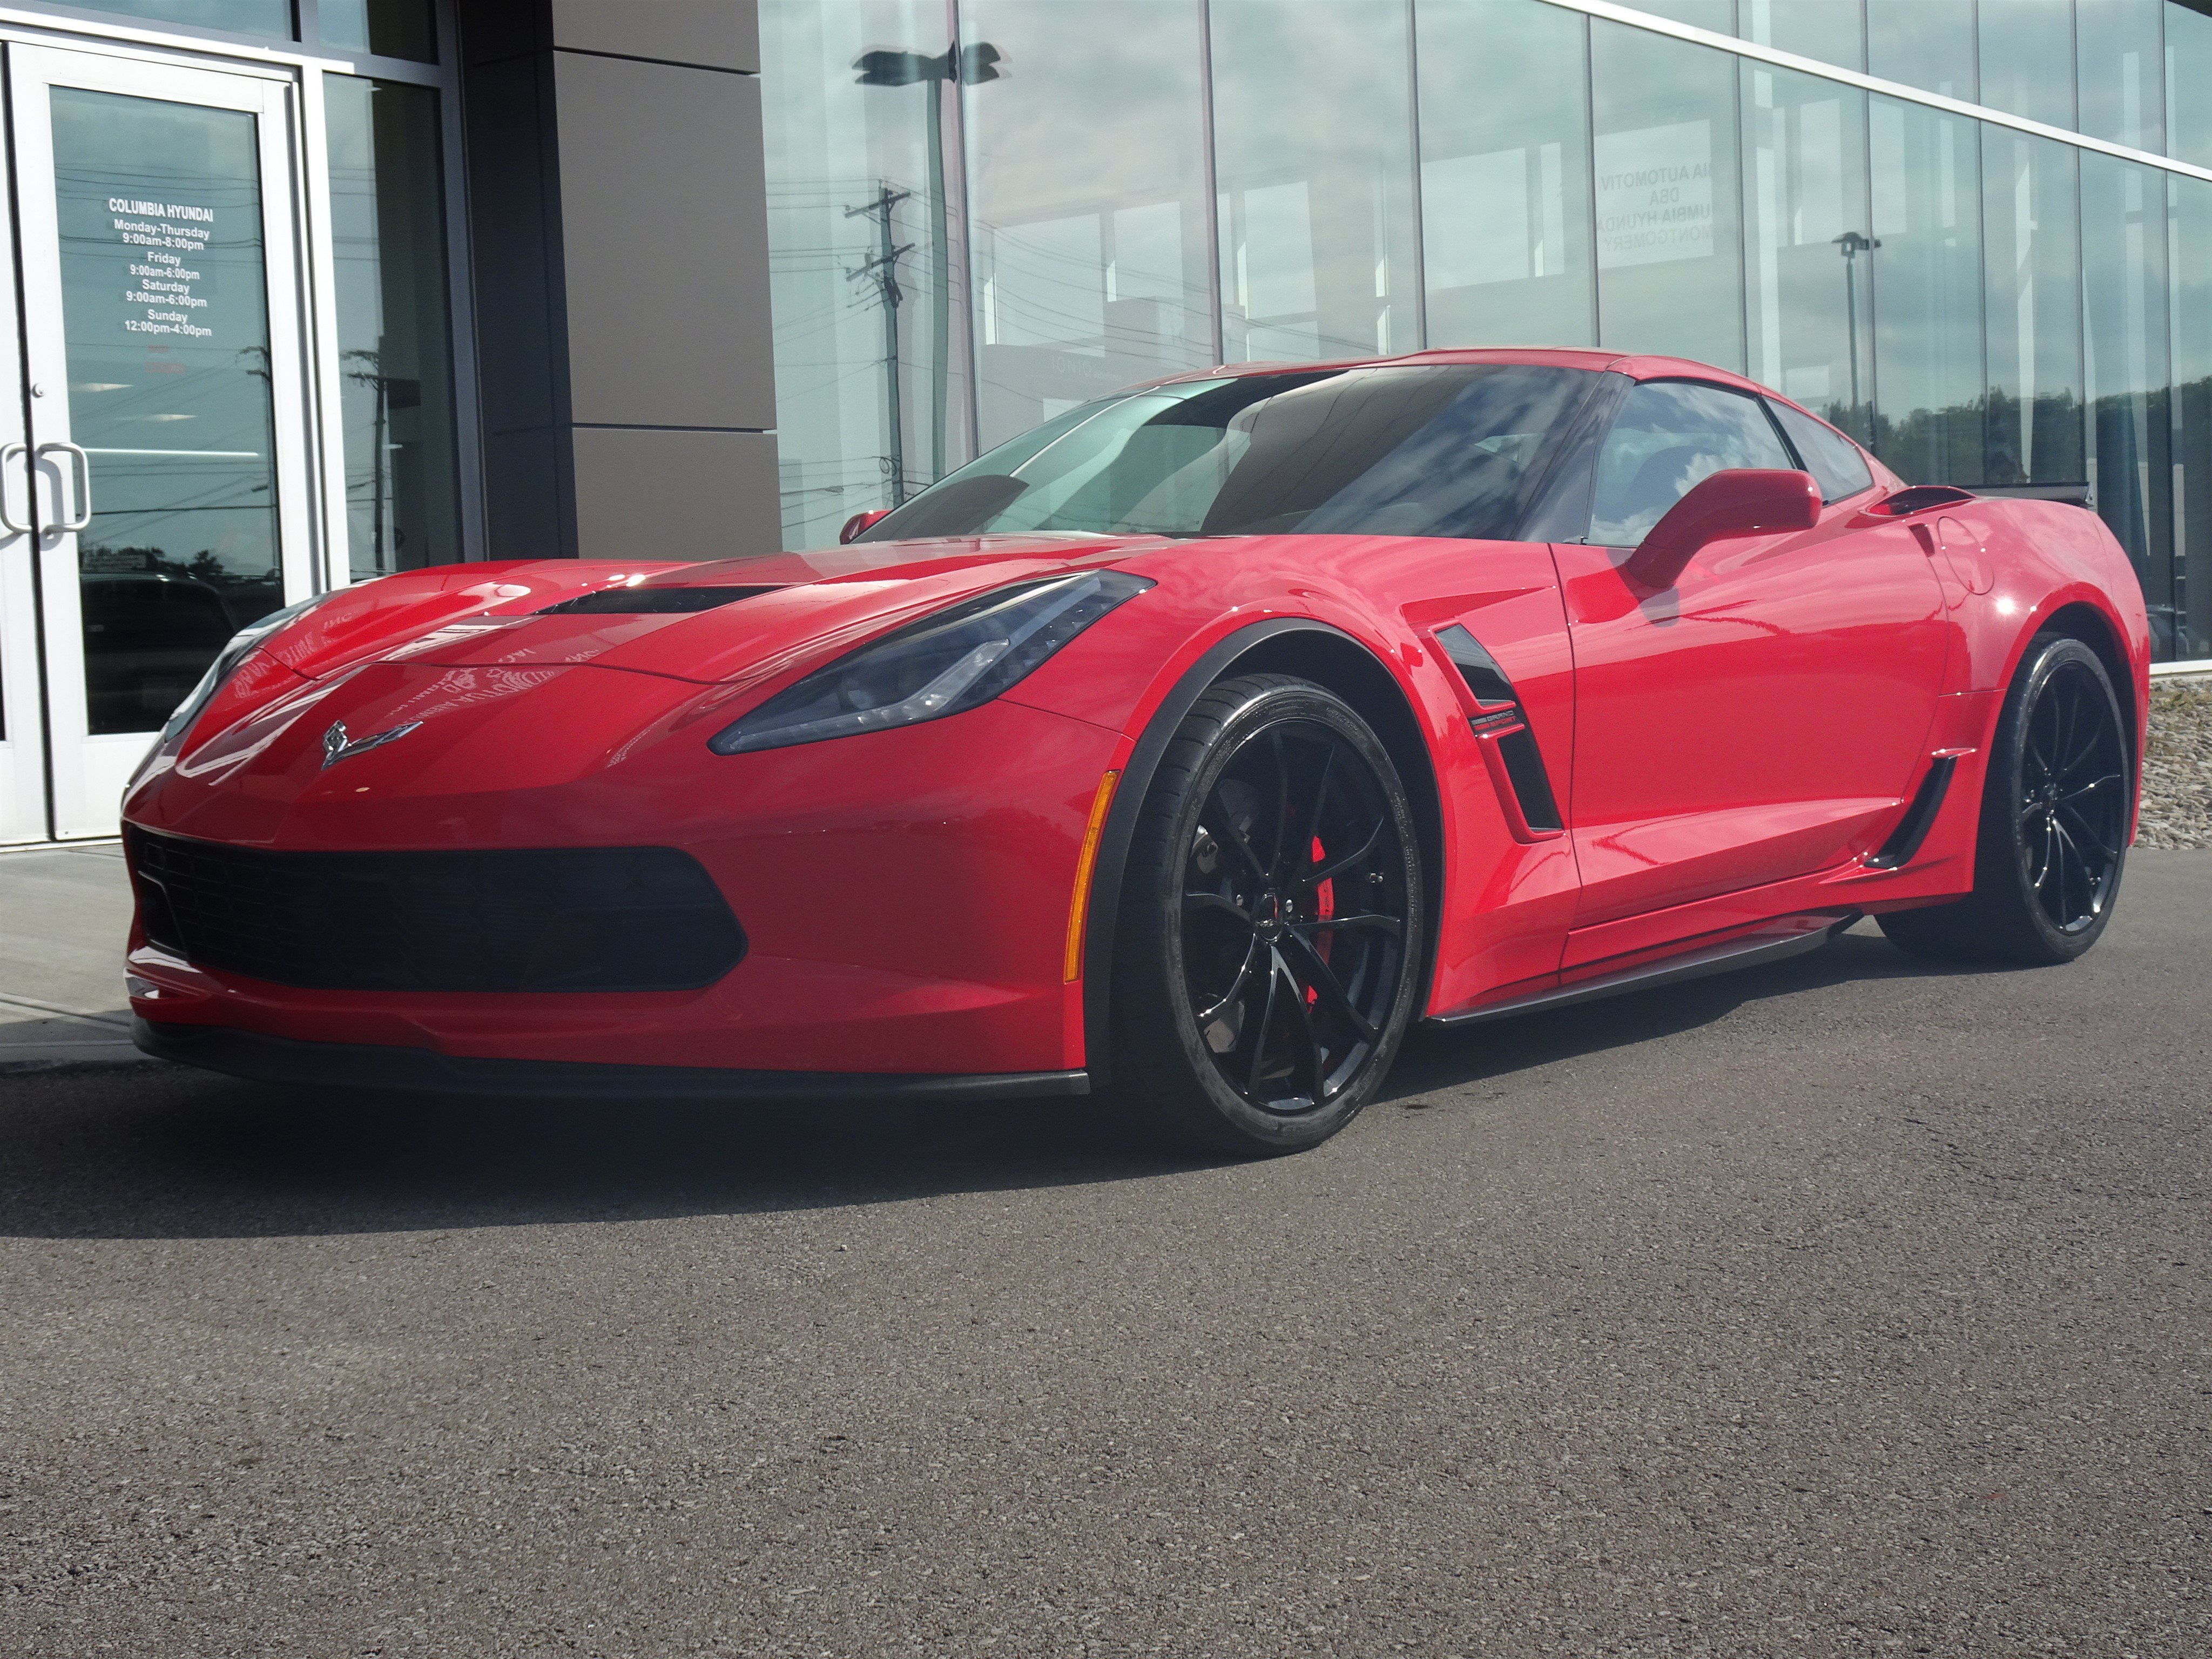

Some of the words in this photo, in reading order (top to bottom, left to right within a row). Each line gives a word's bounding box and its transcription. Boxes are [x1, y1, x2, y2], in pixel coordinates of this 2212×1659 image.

[109, 198, 165, 217] COLUMBIA
[167, 204, 213, 222] HYUNDAI
[114, 219, 210, 240] Monday-Thursday
[123, 232, 204, 251] 9:00am-8:00pm
[147, 252, 181, 266] Friday
[130, 264, 200, 281] 9:00am-6:00pm
[142, 279, 190, 295] Saturday
[126, 291, 207, 308] 9:00am-6:00pm
[147, 309, 188, 324] Sunday
[125, 320, 212, 338] 12:00pm-4:00pm
